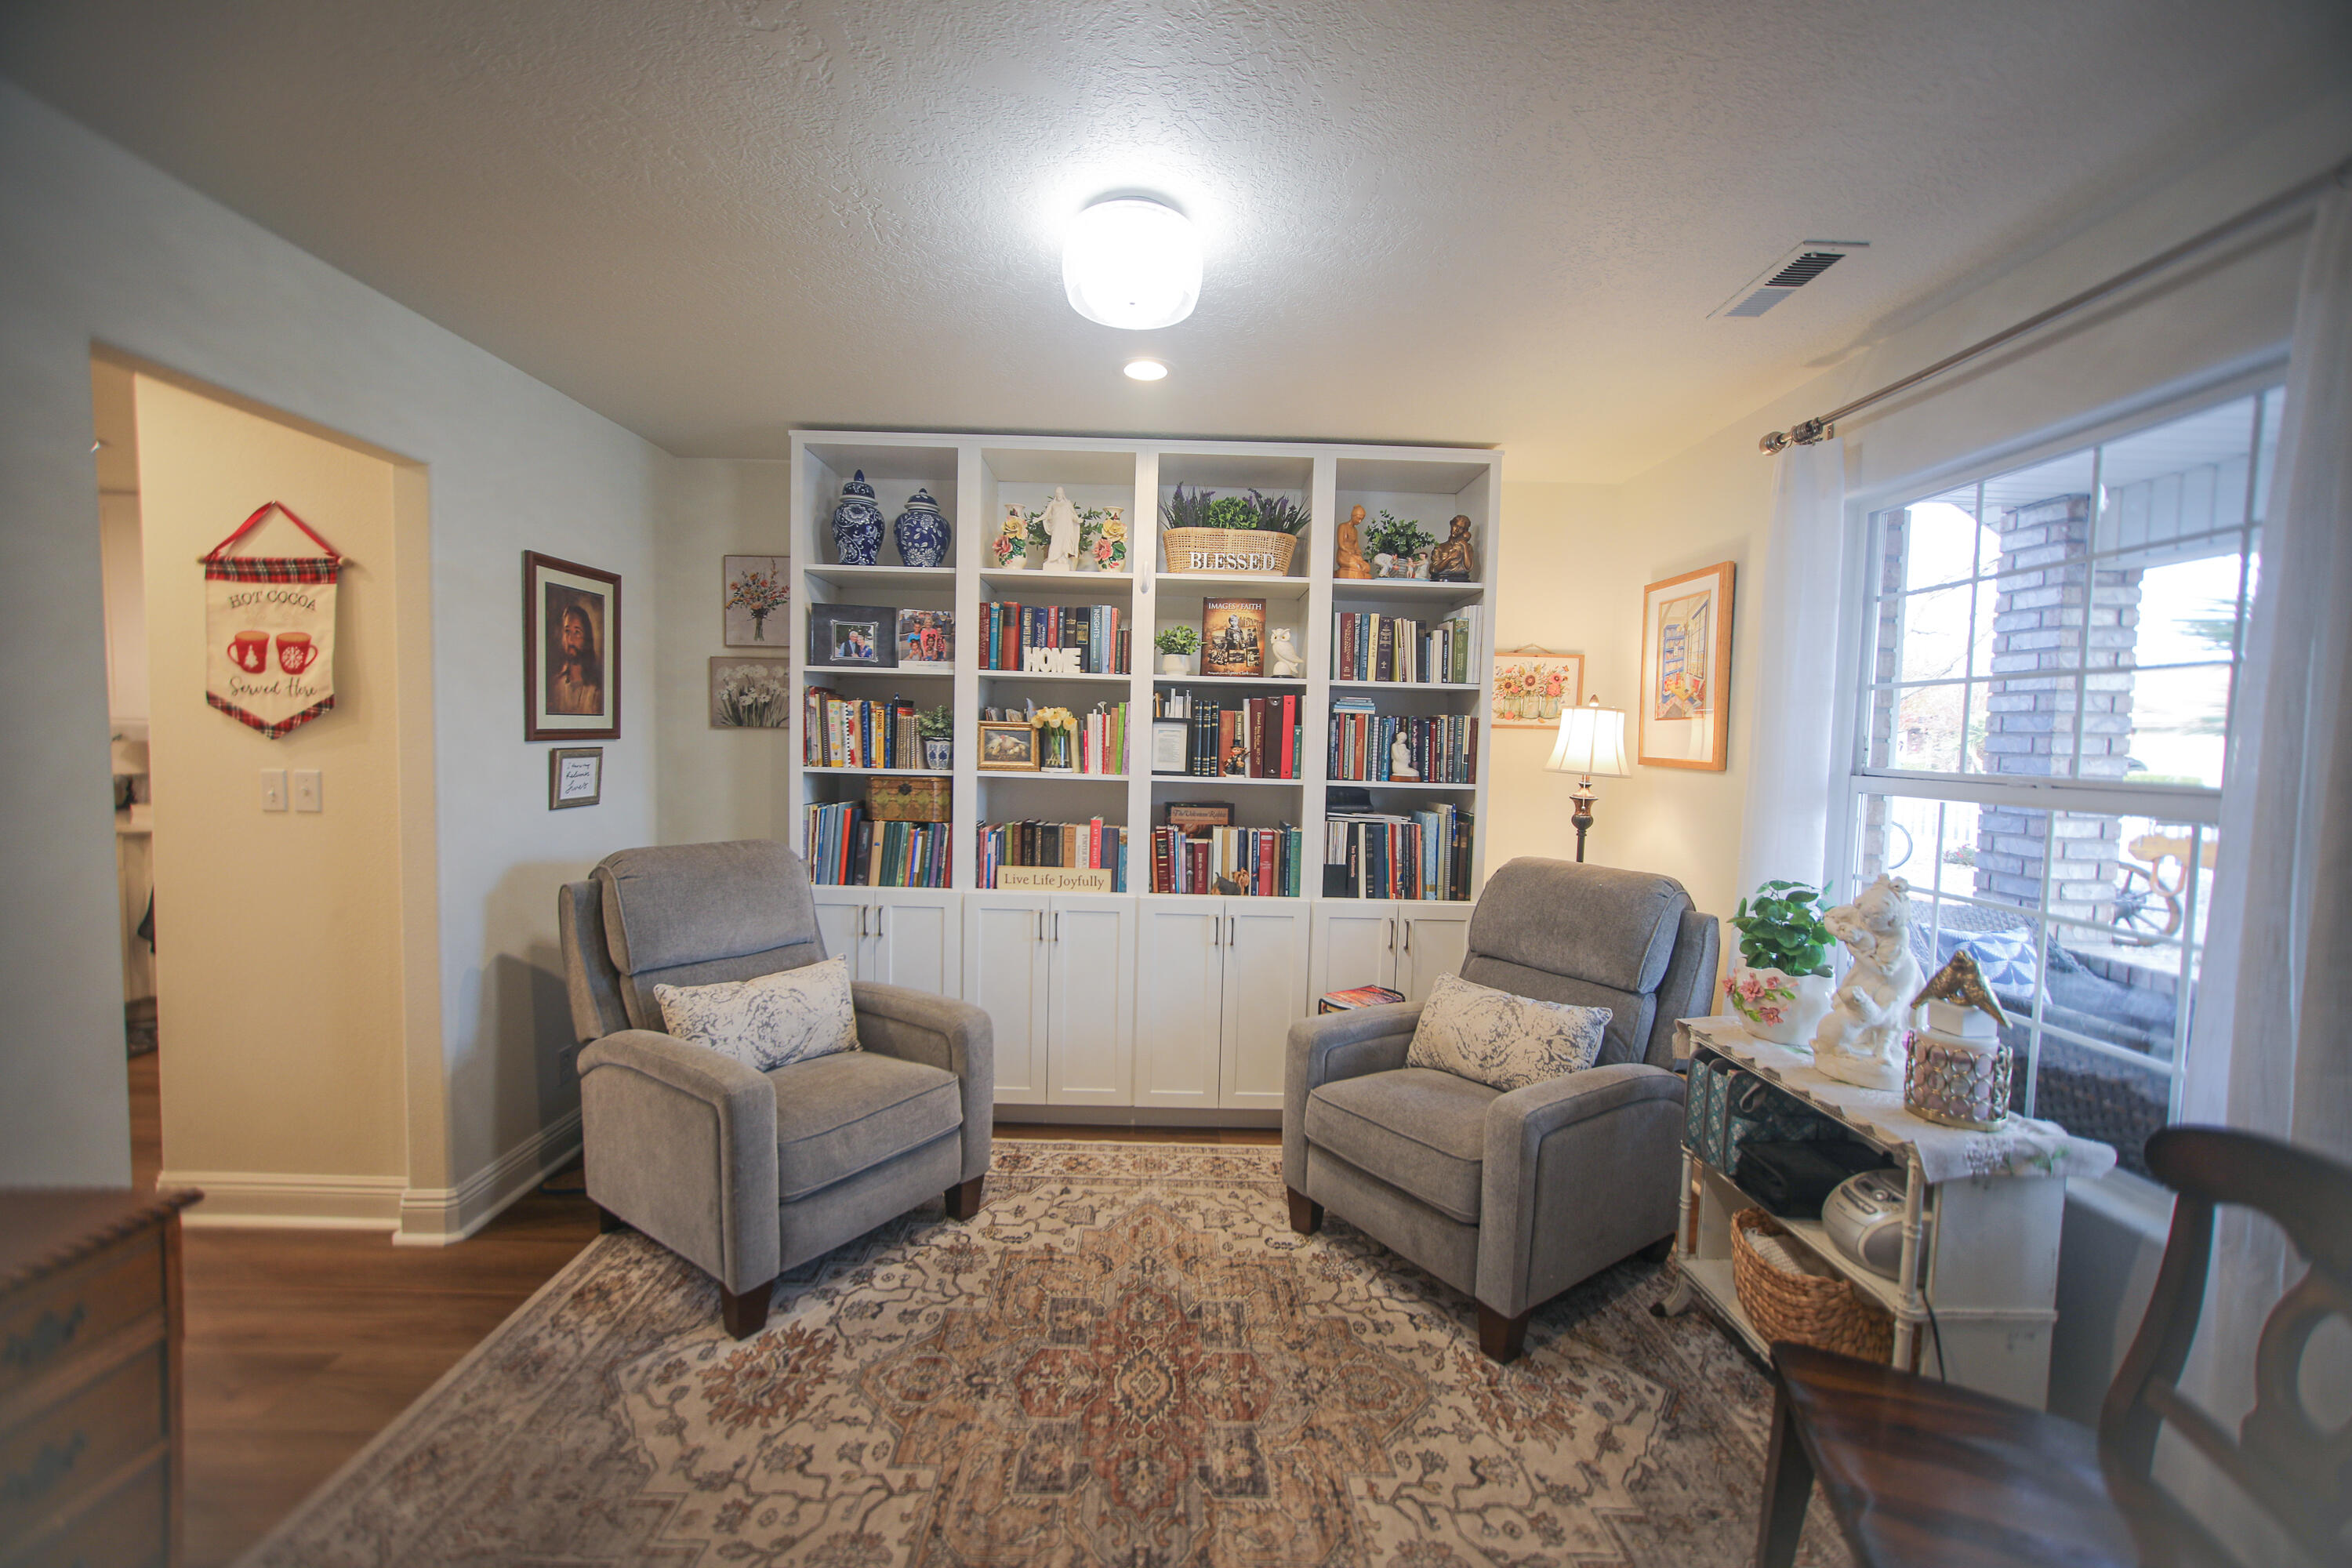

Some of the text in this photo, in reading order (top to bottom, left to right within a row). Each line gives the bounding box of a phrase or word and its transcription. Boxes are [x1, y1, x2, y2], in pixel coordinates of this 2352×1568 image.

[1189, 552, 1276, 571] BLESSED
[228, 590, 318, 612] HOT COCOA
[1023, 647, 1081, 673] HOME
[229, 676, 318, 697] Served Here
[1004, 873, 1105, 891] Live Life Joyfully
